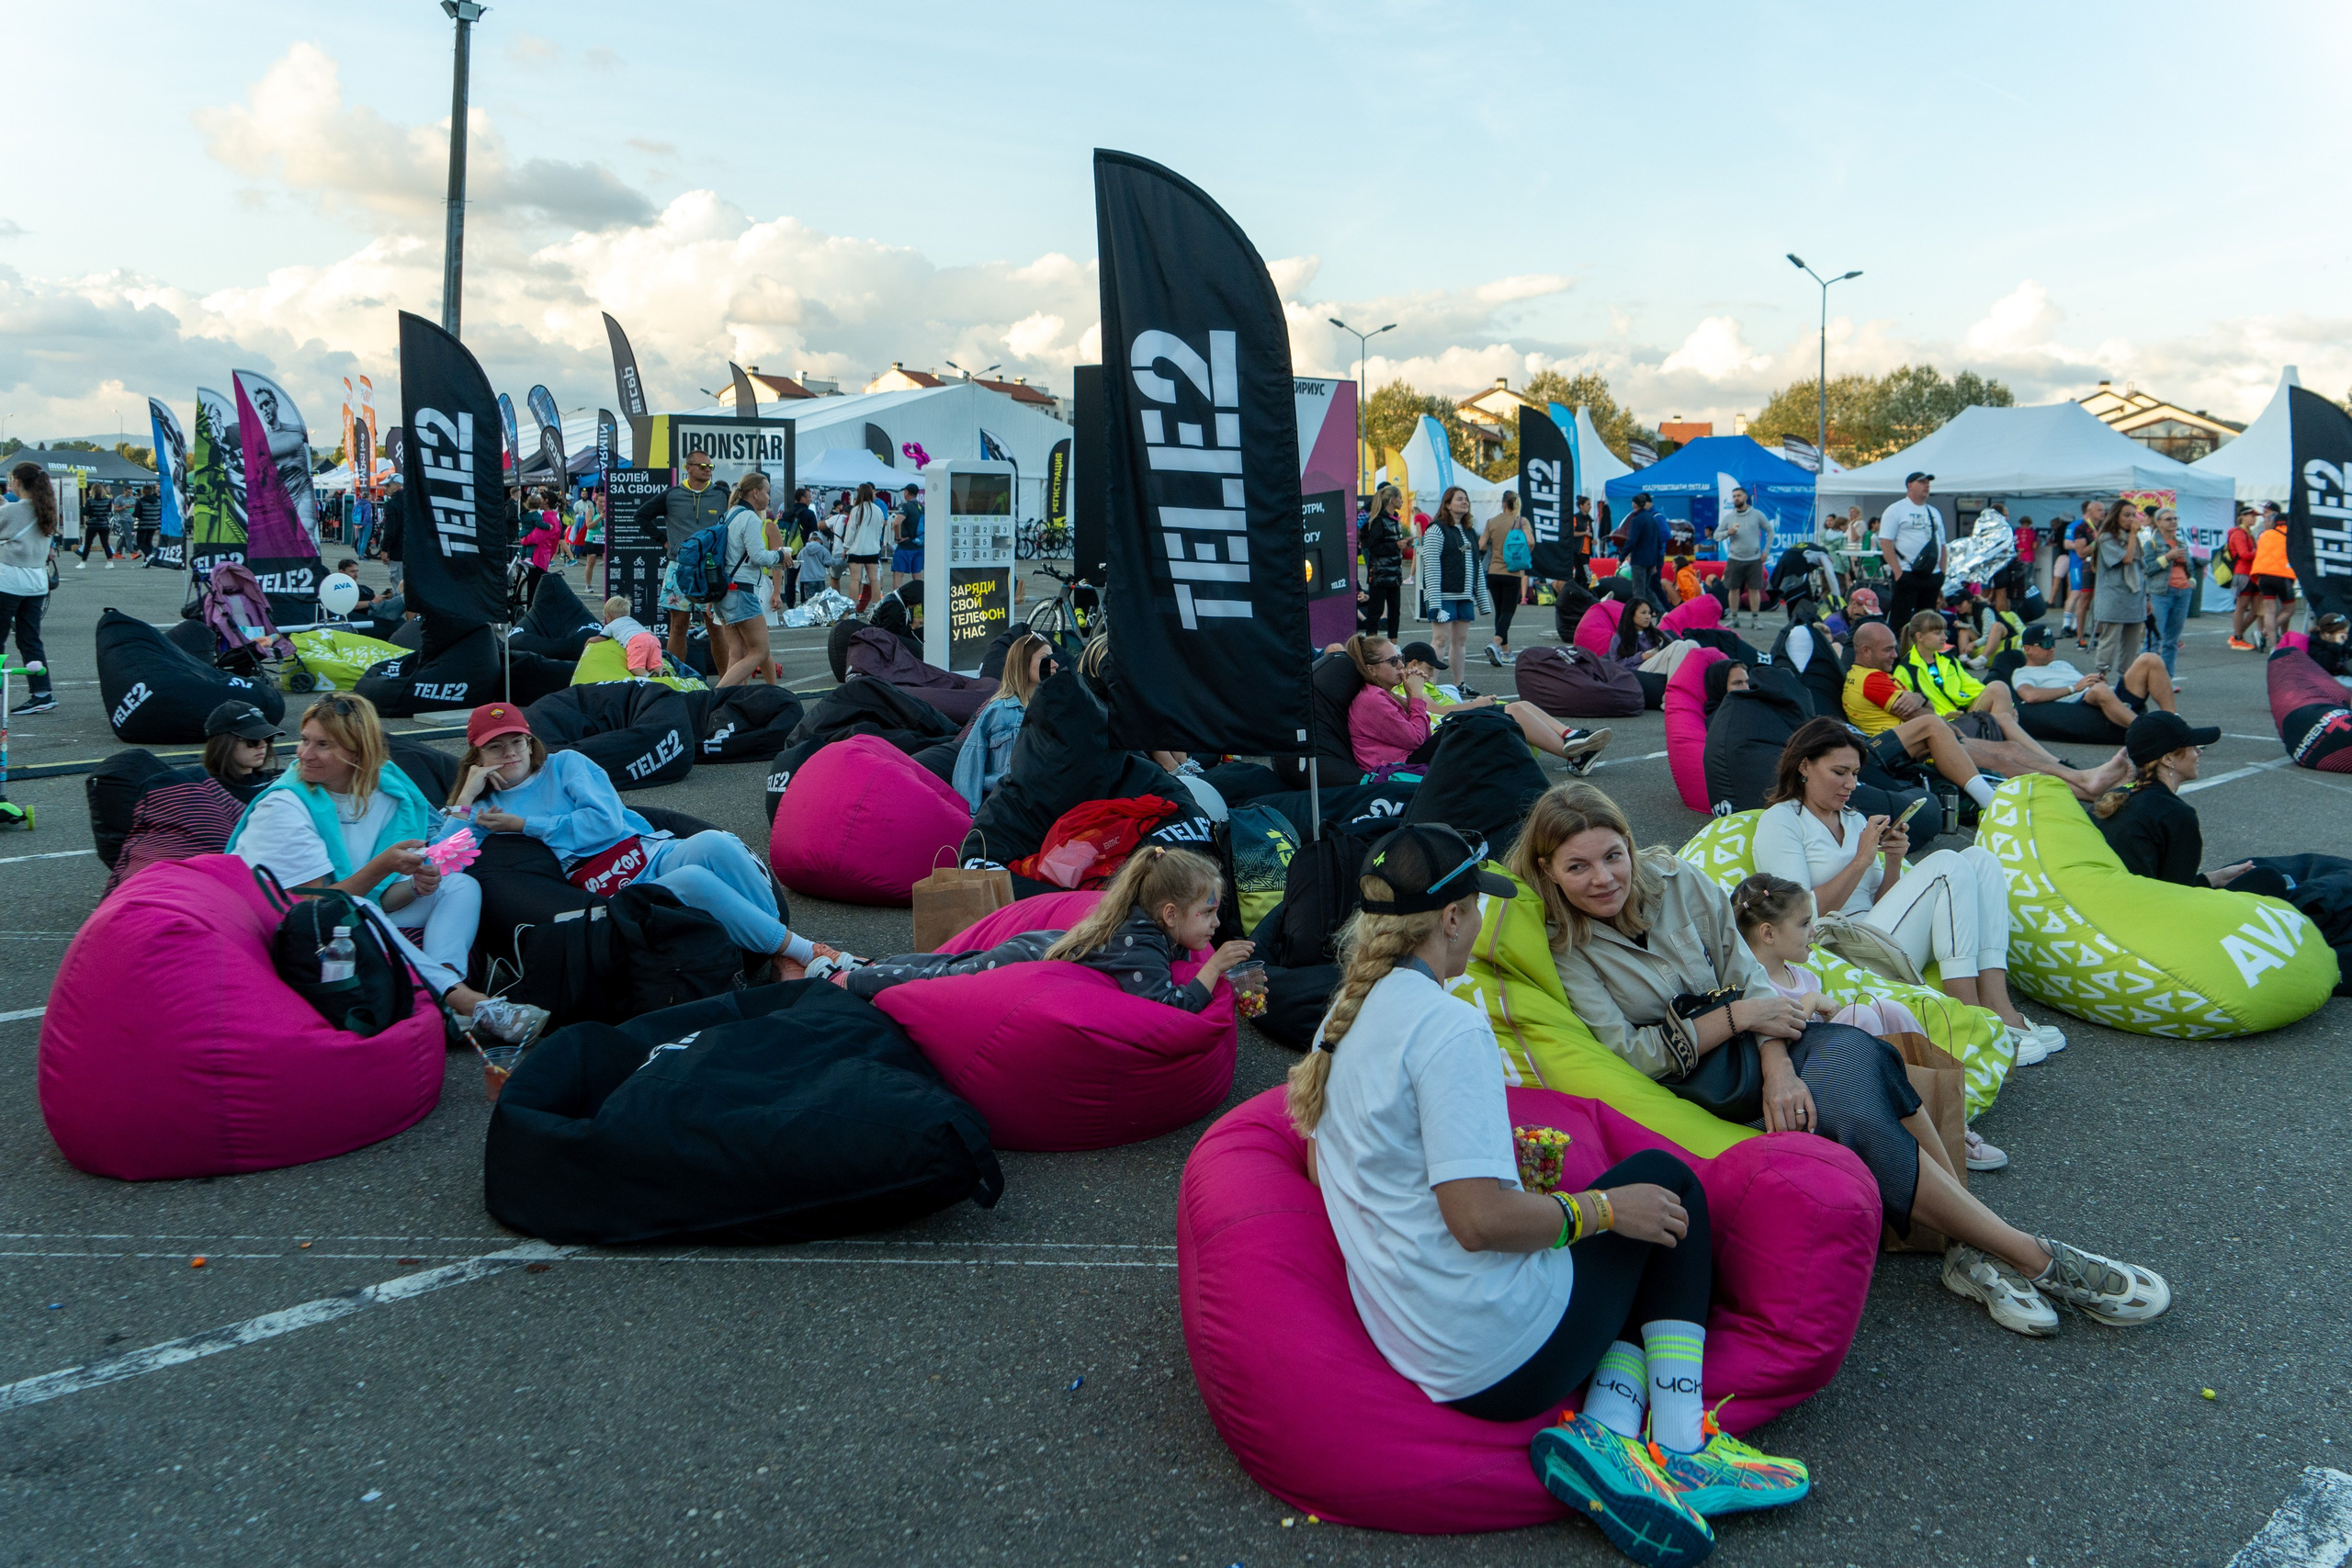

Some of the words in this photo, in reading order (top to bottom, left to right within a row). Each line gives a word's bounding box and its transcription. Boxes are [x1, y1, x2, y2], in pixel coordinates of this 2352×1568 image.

[682, 432, 783, 460] IRONSTAR
[48, 462, 68, 471] IRON
[610, 470, 649, 482] БОЛЕЙ
[414, 407, 480, 557] TELE2
[1052, 452, 1063, 513] РЕГИСТРАЦИЯ
[1131, 329, 1252, 629] TELE2
[610, 484, 625, 494] ЗА
[628, 484, 668, 494] СВОИХ
[1527, 458, 1561, 543] TELE2
[1304, 531, 1320, 543] ОГУ
[334, 582, 353, 591] AVA
[951, 581, 995, 597] ЗАРЯДИ
[1331, 580, 1346, 590] TELE2
[951, 594, 982, 612] СВОЙ
[952, 607, 1005, 626] ТЕЛЕФОН
[953, 629, 960, 641] У
[963, 625, 987, 639] НАС
[414, 682, 469, 702] TELE2
[112, 682, 153, 728] TELE2
[625, 729, 684, 781] TELE2
[1152, 817, 1213, 842] TELE
[1102, 836, 1120, 851] BMC
[2220, 901, 2307, 989] AVA
